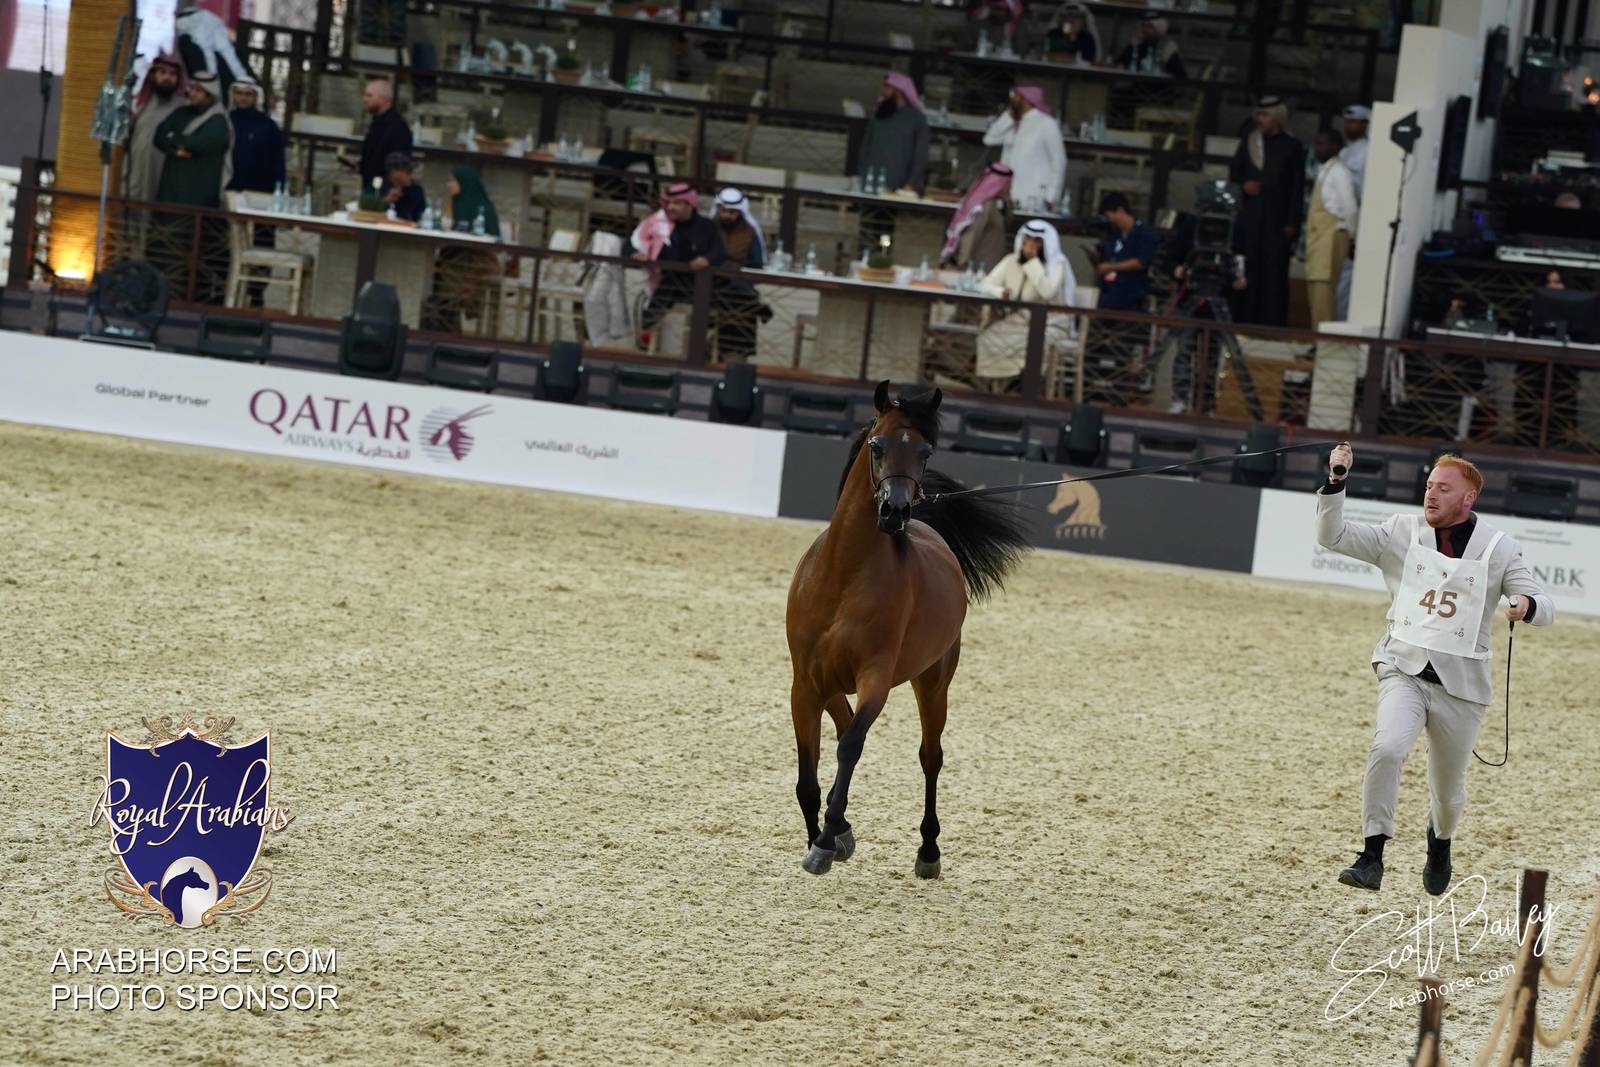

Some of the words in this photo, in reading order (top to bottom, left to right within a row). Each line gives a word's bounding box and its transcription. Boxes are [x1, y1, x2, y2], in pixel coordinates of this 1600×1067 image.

[95, 383, 145, 399] Global
[148, 390, 209, 407] Partner
[249, 388, 411, 442] QATAR
[284, 432, 354, 452] AIRWAYS
[1419, 589, 1457, 618] 45
